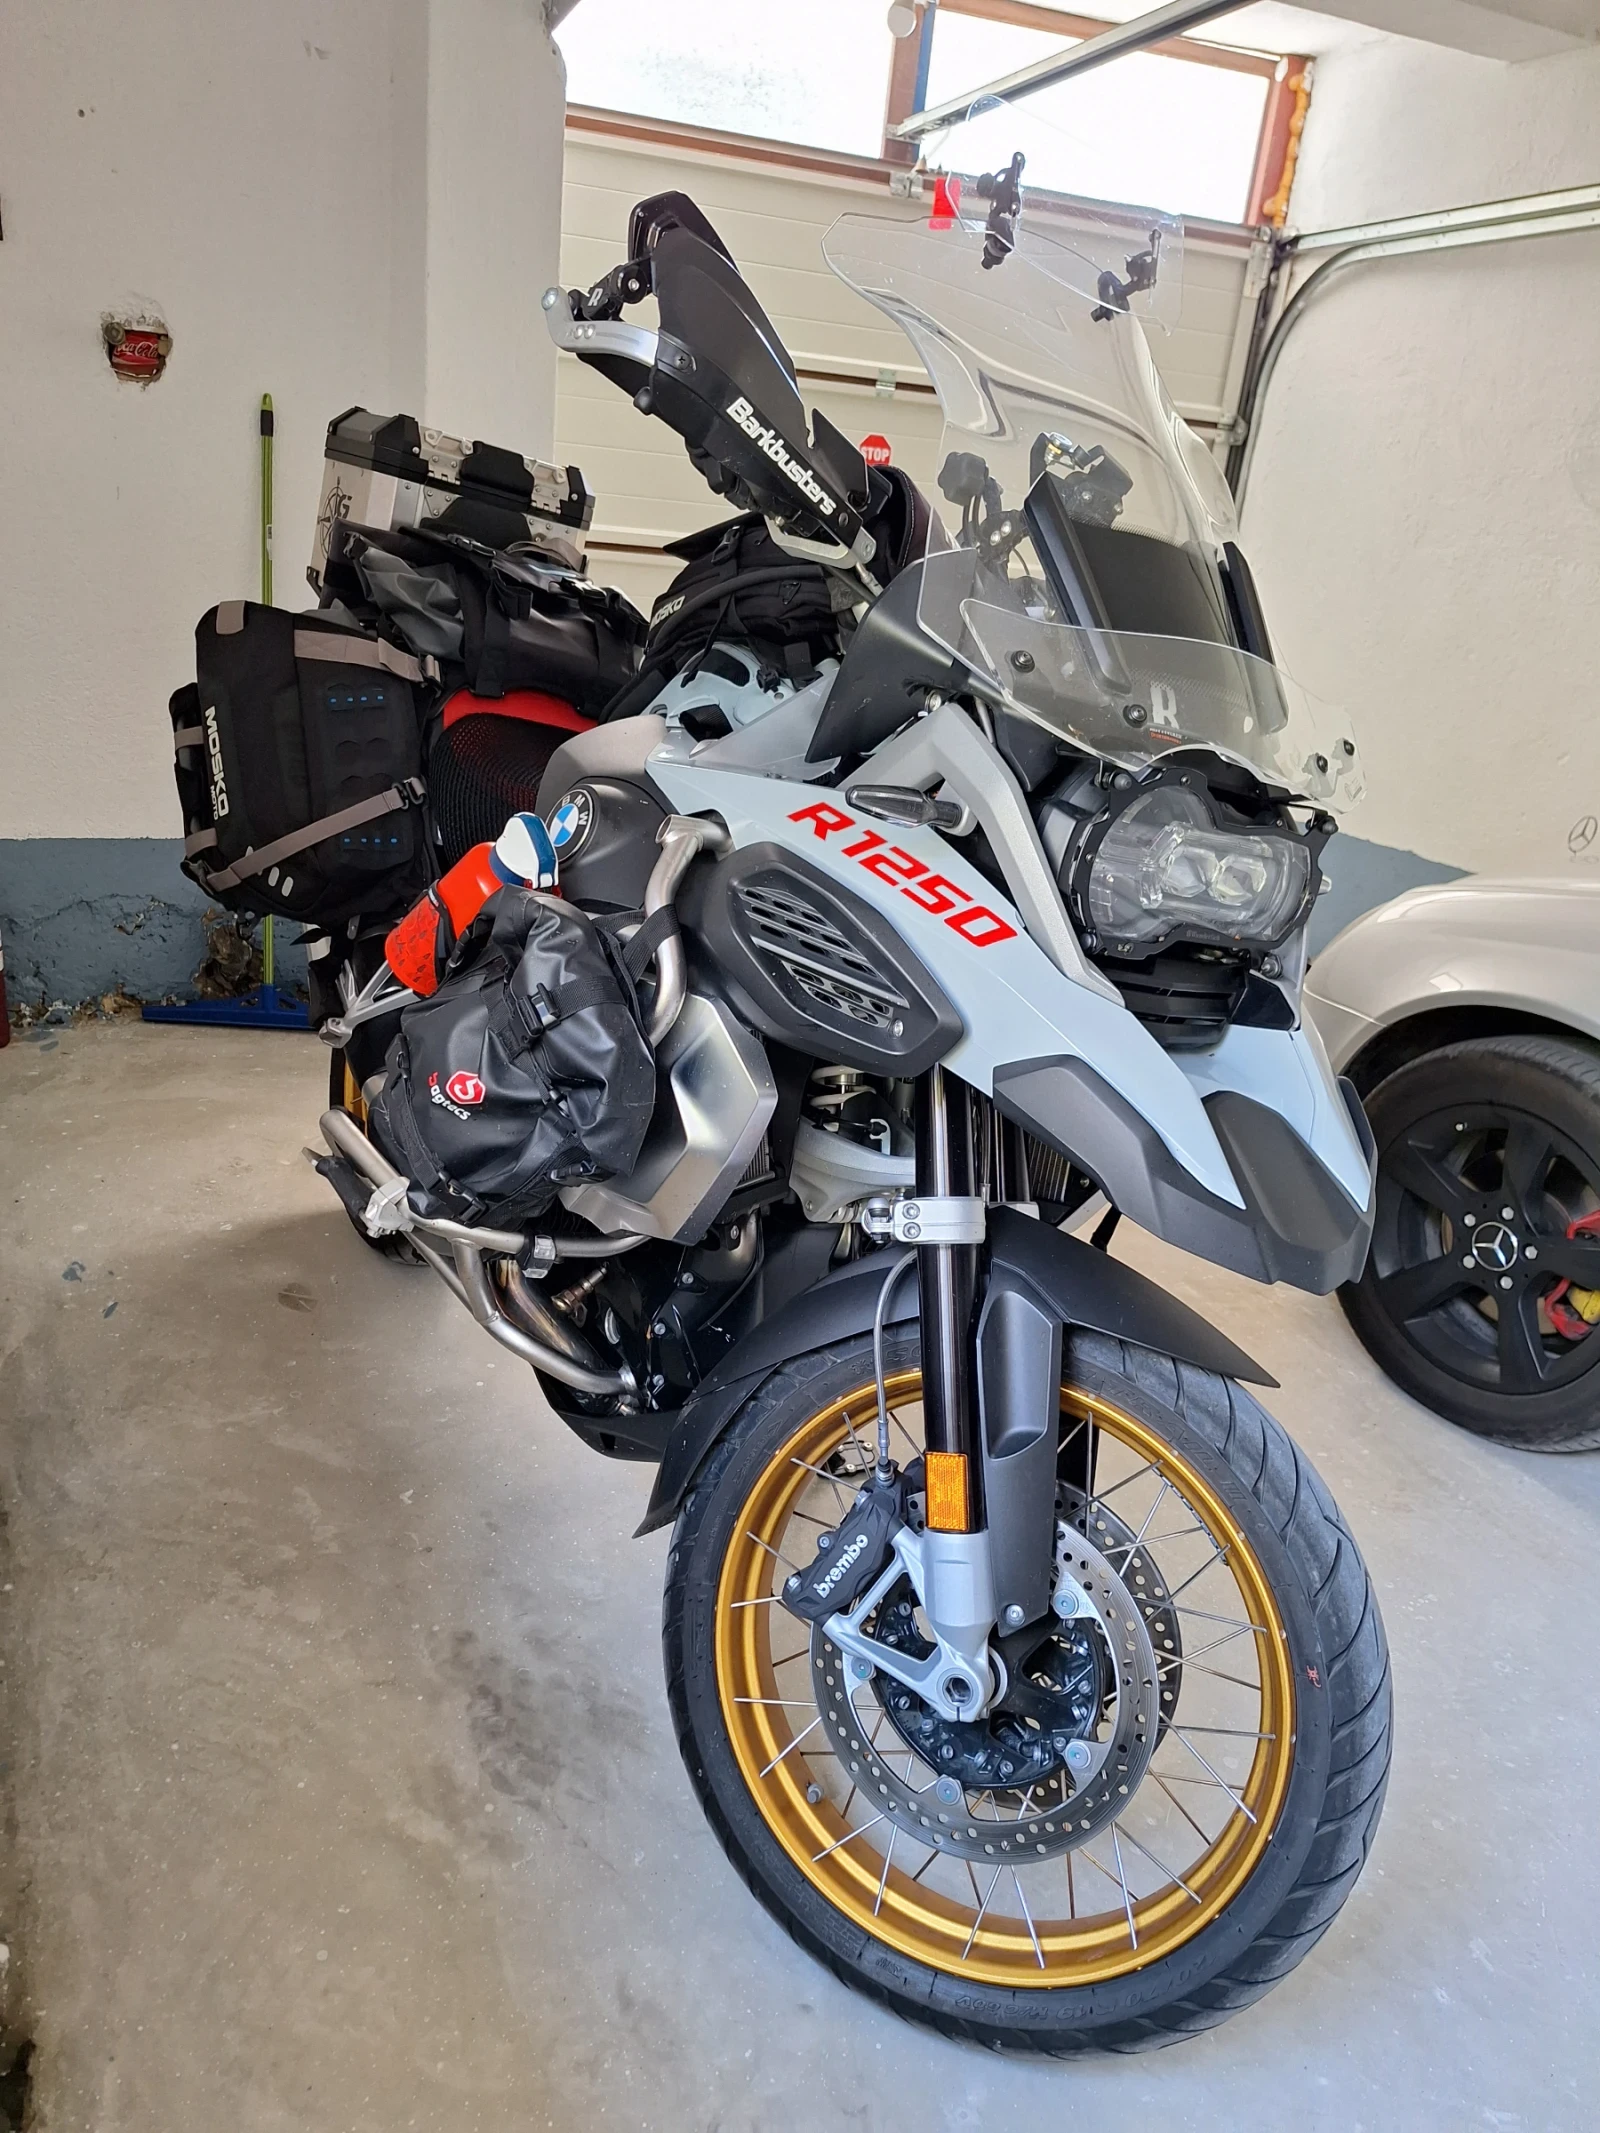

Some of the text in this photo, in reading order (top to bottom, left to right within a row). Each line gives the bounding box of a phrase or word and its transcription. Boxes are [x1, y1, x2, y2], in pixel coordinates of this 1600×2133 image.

[726, 397, 837, 515] Barkbusters
[861, 446, 889, 462] STOP
[205, 705, 229, 817] MOSKO
[210, 785, 218, 820] MOTO
[561, 794, 588, 825] BMW
[813, 1534, 868, 1598] brembo
